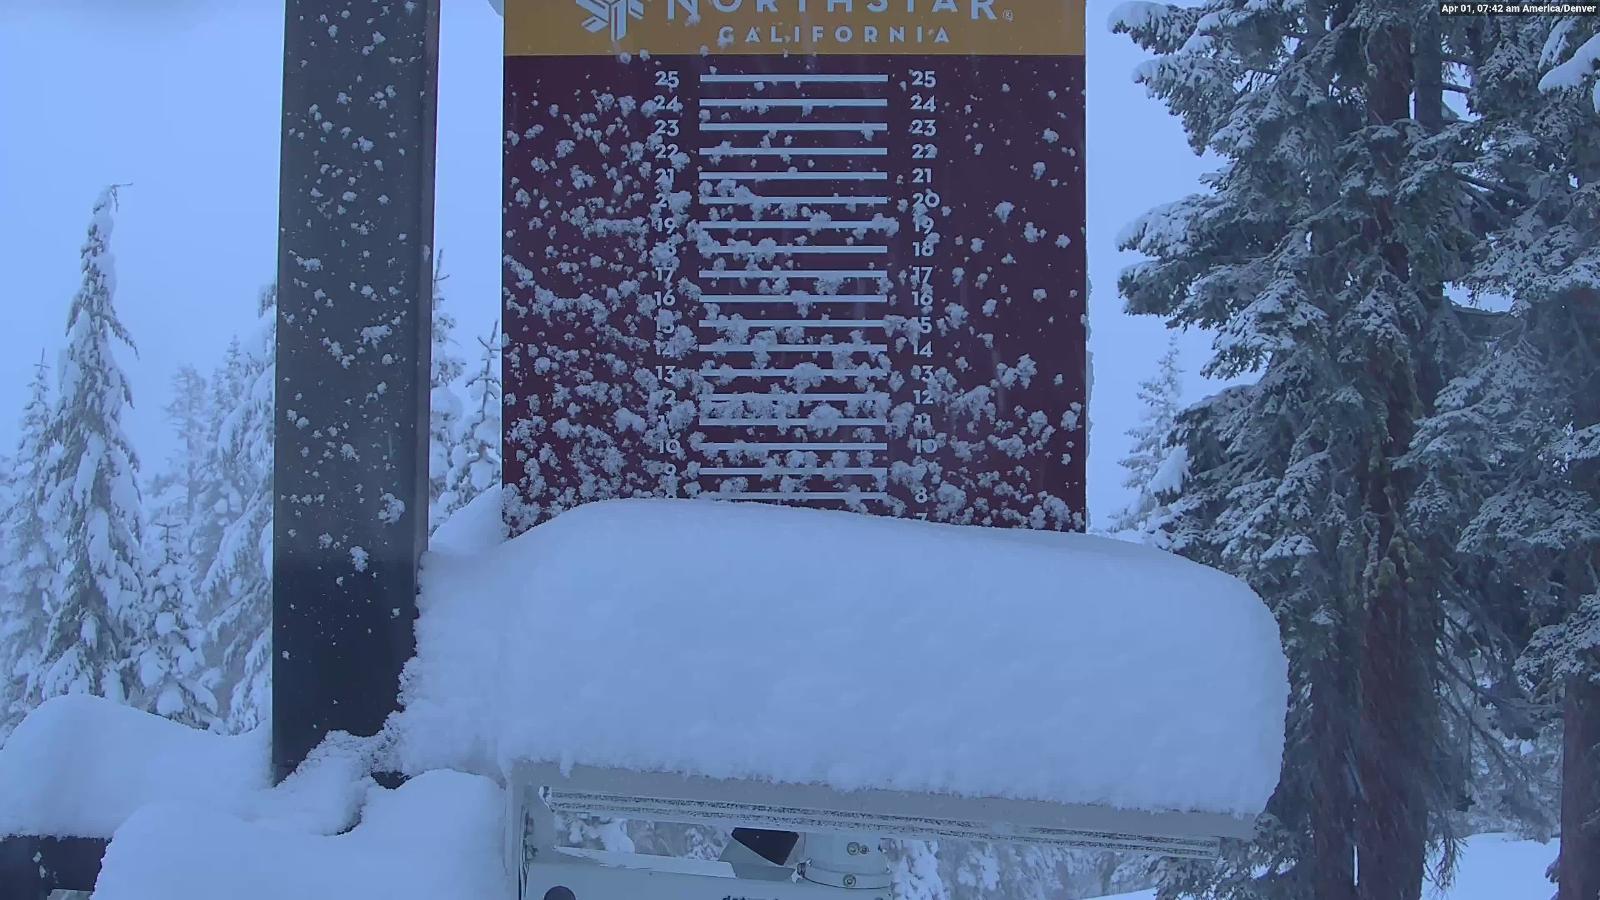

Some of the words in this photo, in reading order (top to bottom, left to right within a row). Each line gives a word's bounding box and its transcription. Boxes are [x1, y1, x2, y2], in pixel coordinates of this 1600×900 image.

[719, 26, 950, 43] CALIFORNIA
[655, 70, 679, 87] 25
[911, 70, 936, 87] 25
[654, 95, 679, 112] 24
[911, 94, 936, 112] 24
[654, 119, 679, 136] 23
[911, 119, 936, 136] 23
[655, 144, 679, 159] 22
[912, 144, 937, 159] 22
[655, 168, 674, 184] 21
[912, 168, 932, 183] 21
[912, 192, 940, 208] 20
[656, 217, 676, 234] 19
[913, 217, 933, 234] 19
[913, 240, 934, 256] 18
[655, 267, 675, 283] 17
[912, 267, 932, 283] 17
[654, 289, 675, 306] 16
[912, 290, 933, 306] 16
[913, 341, 933, 357] 14
[655, 366, 677, 383] 13
[913, 390, 933, 404] 12
[658, 440, 680, 454] 10
[914, 439, 937, 454] 10
[914, 486, 928, 503] 8
